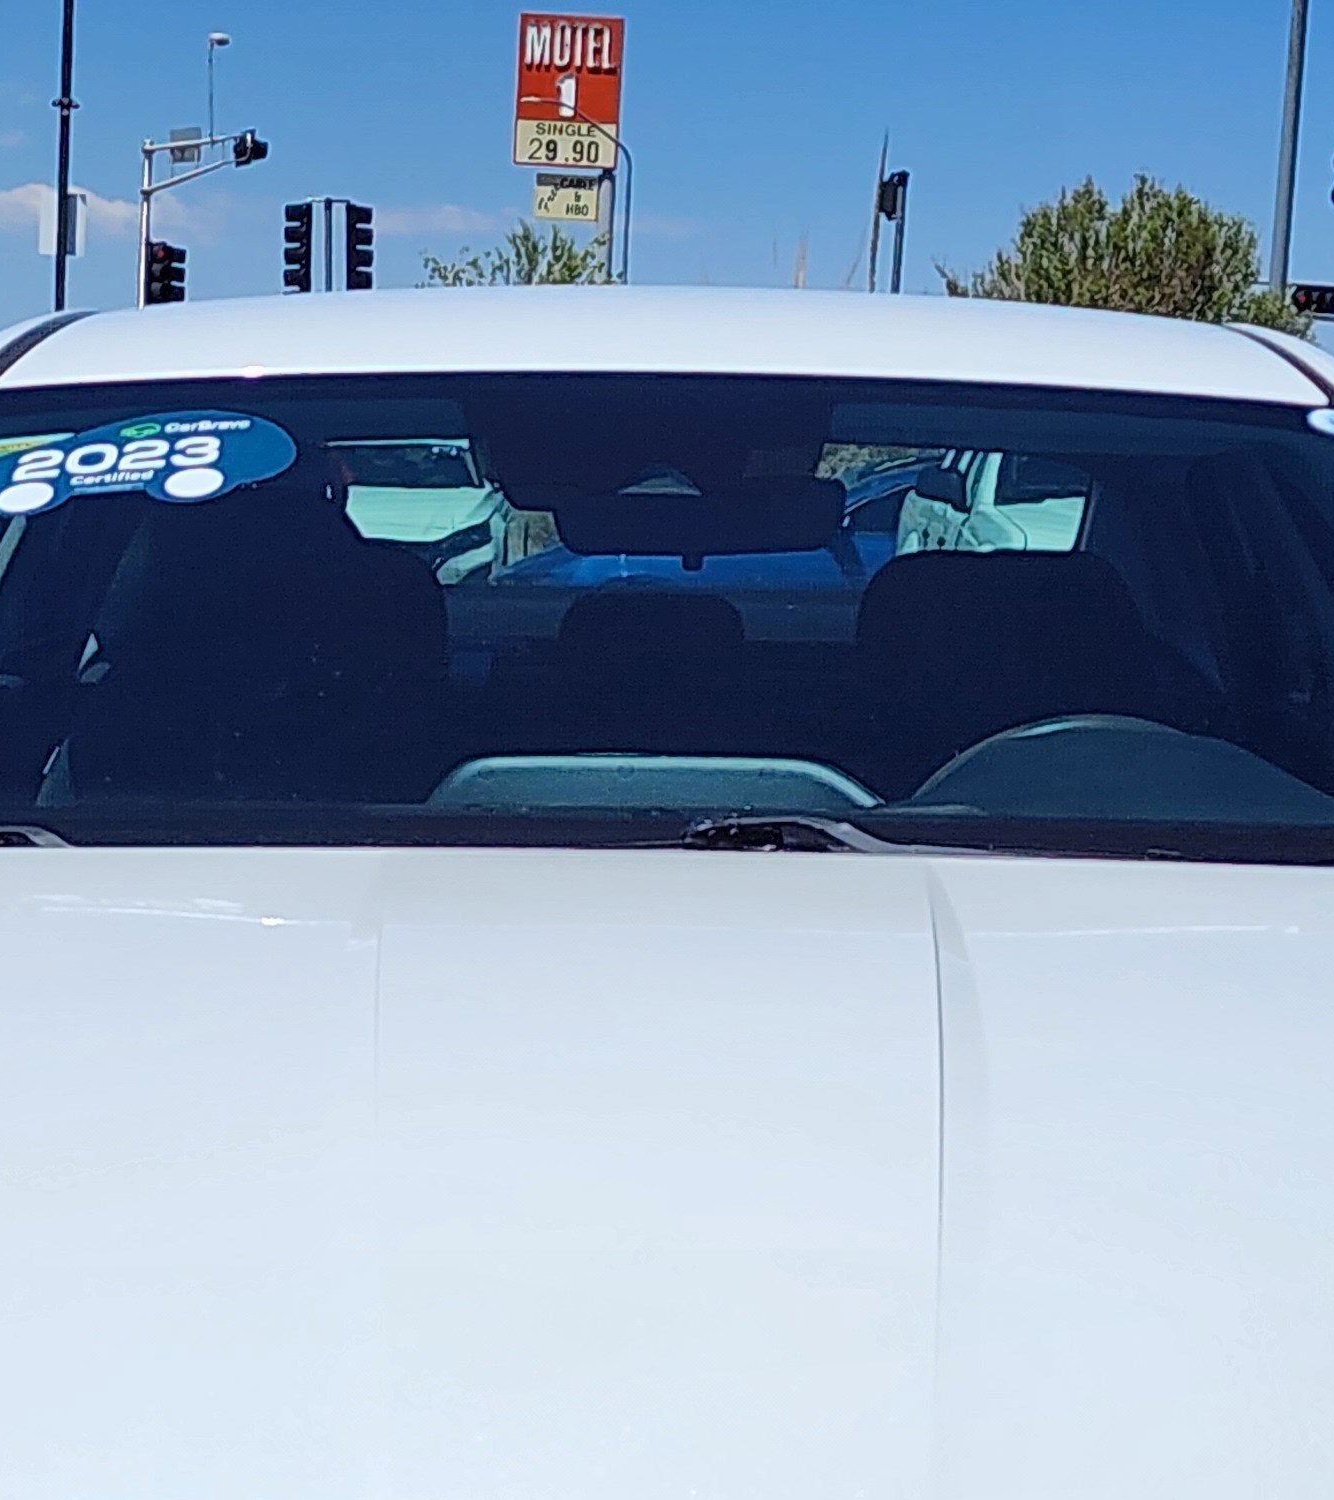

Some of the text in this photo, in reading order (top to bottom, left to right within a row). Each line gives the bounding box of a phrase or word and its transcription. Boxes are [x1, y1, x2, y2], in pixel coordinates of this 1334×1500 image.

[524, 22, 616, 71] MOTEL
[556, 72, 577, 119] 1
[535, 122, 597, 138] SINGLE
[565, 203, 589, 216] HBO
[12, 435, 221, 482] 2023
[69, 468, 155, 487] Certified
